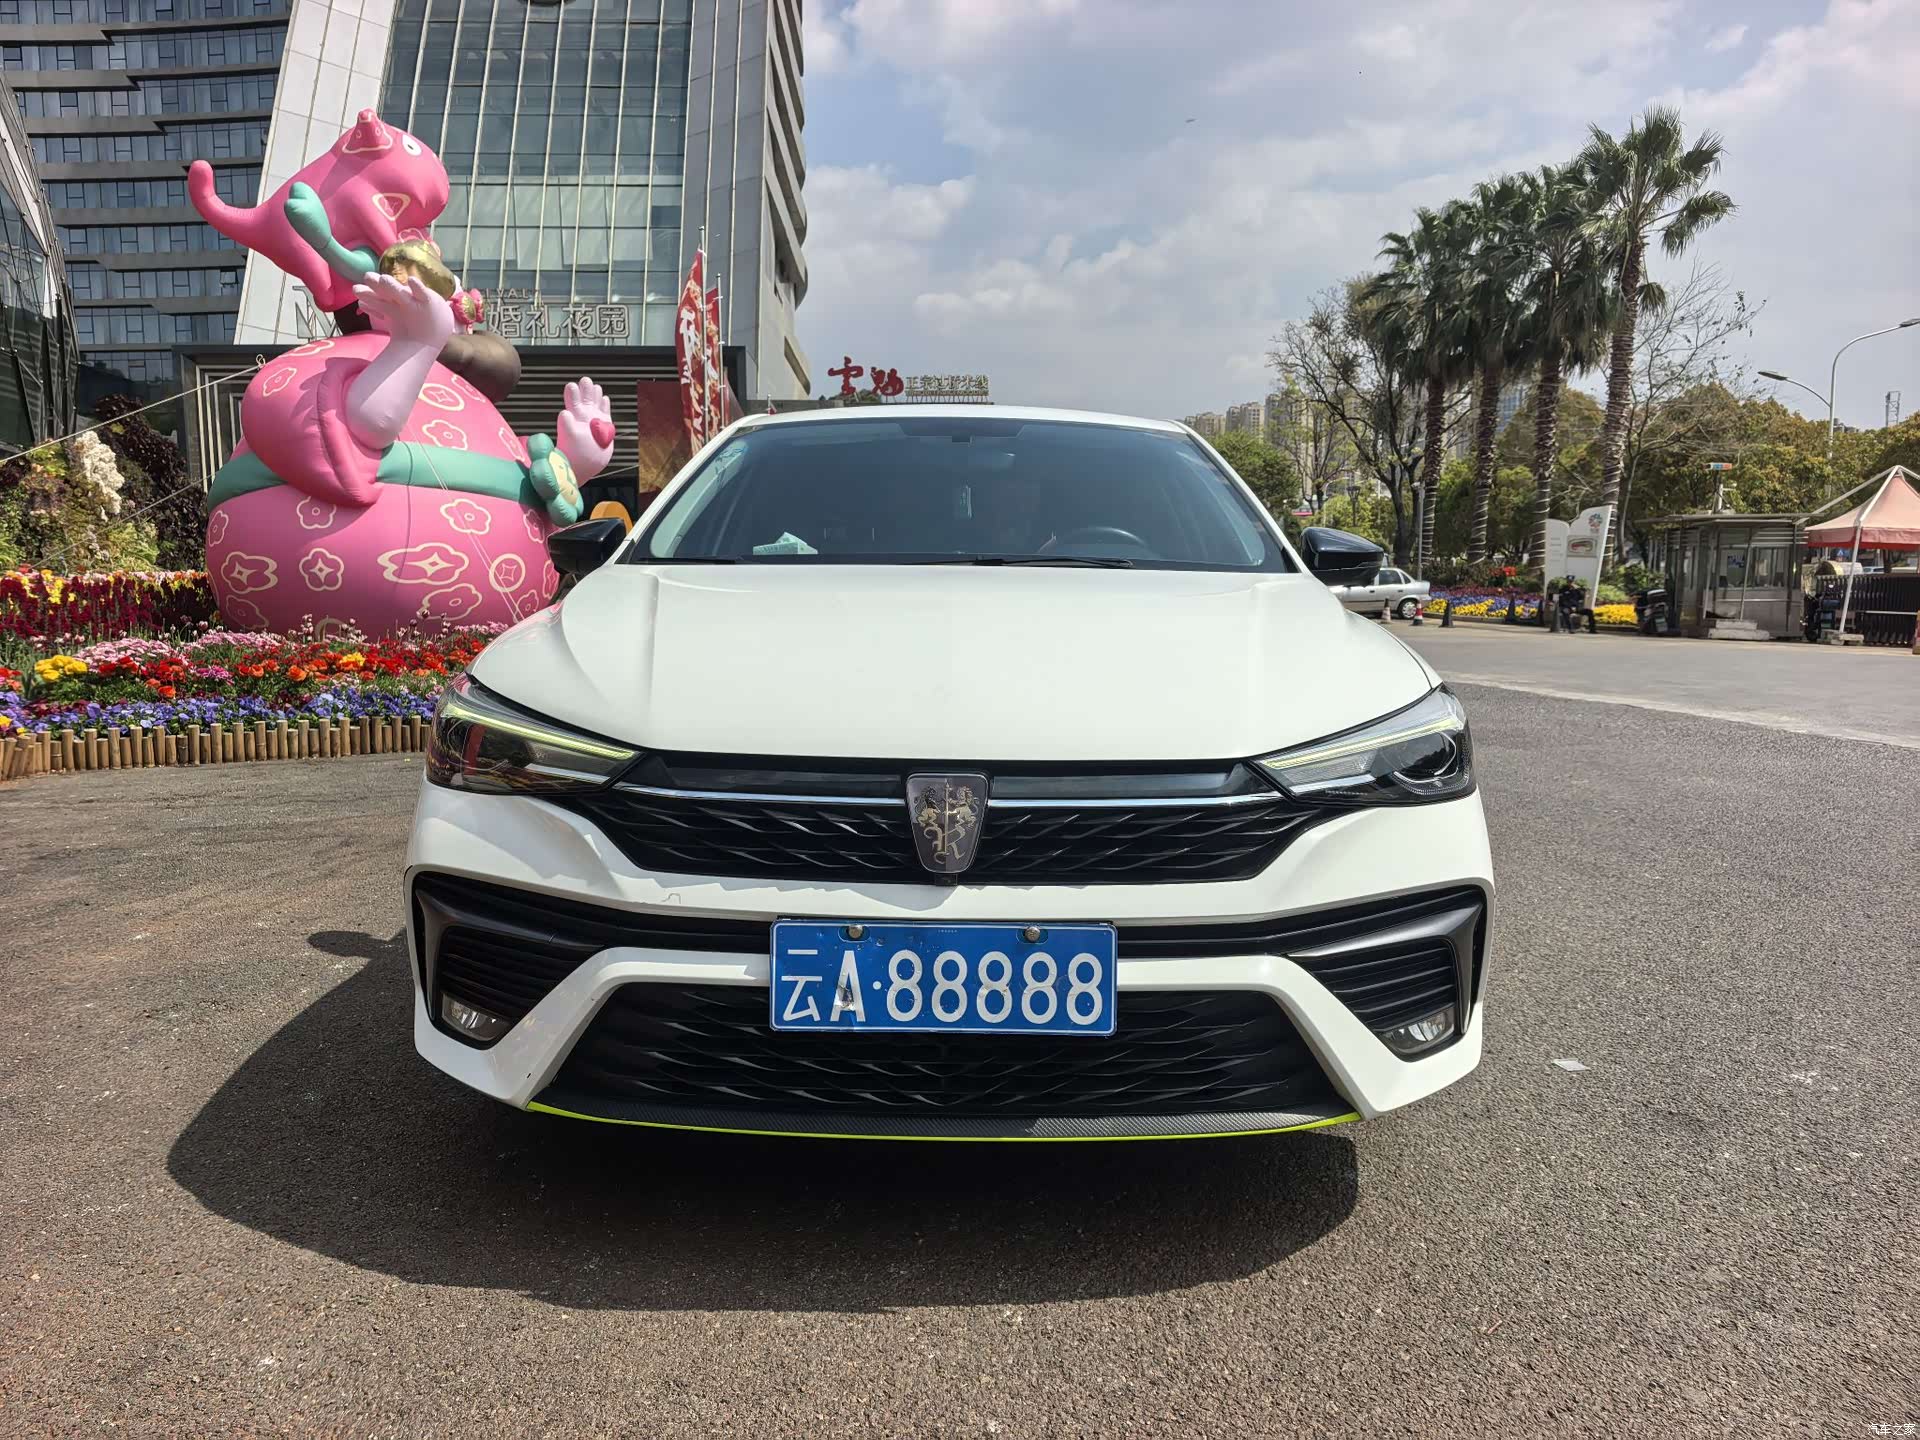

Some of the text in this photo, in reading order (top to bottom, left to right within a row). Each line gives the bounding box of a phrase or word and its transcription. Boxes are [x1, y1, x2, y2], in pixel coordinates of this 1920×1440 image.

[485, 288, 529, 299] IVAL
[488, 303, 630, 338] 婚礼花园
[780, 948, 1104, 1026] 云A·88888
